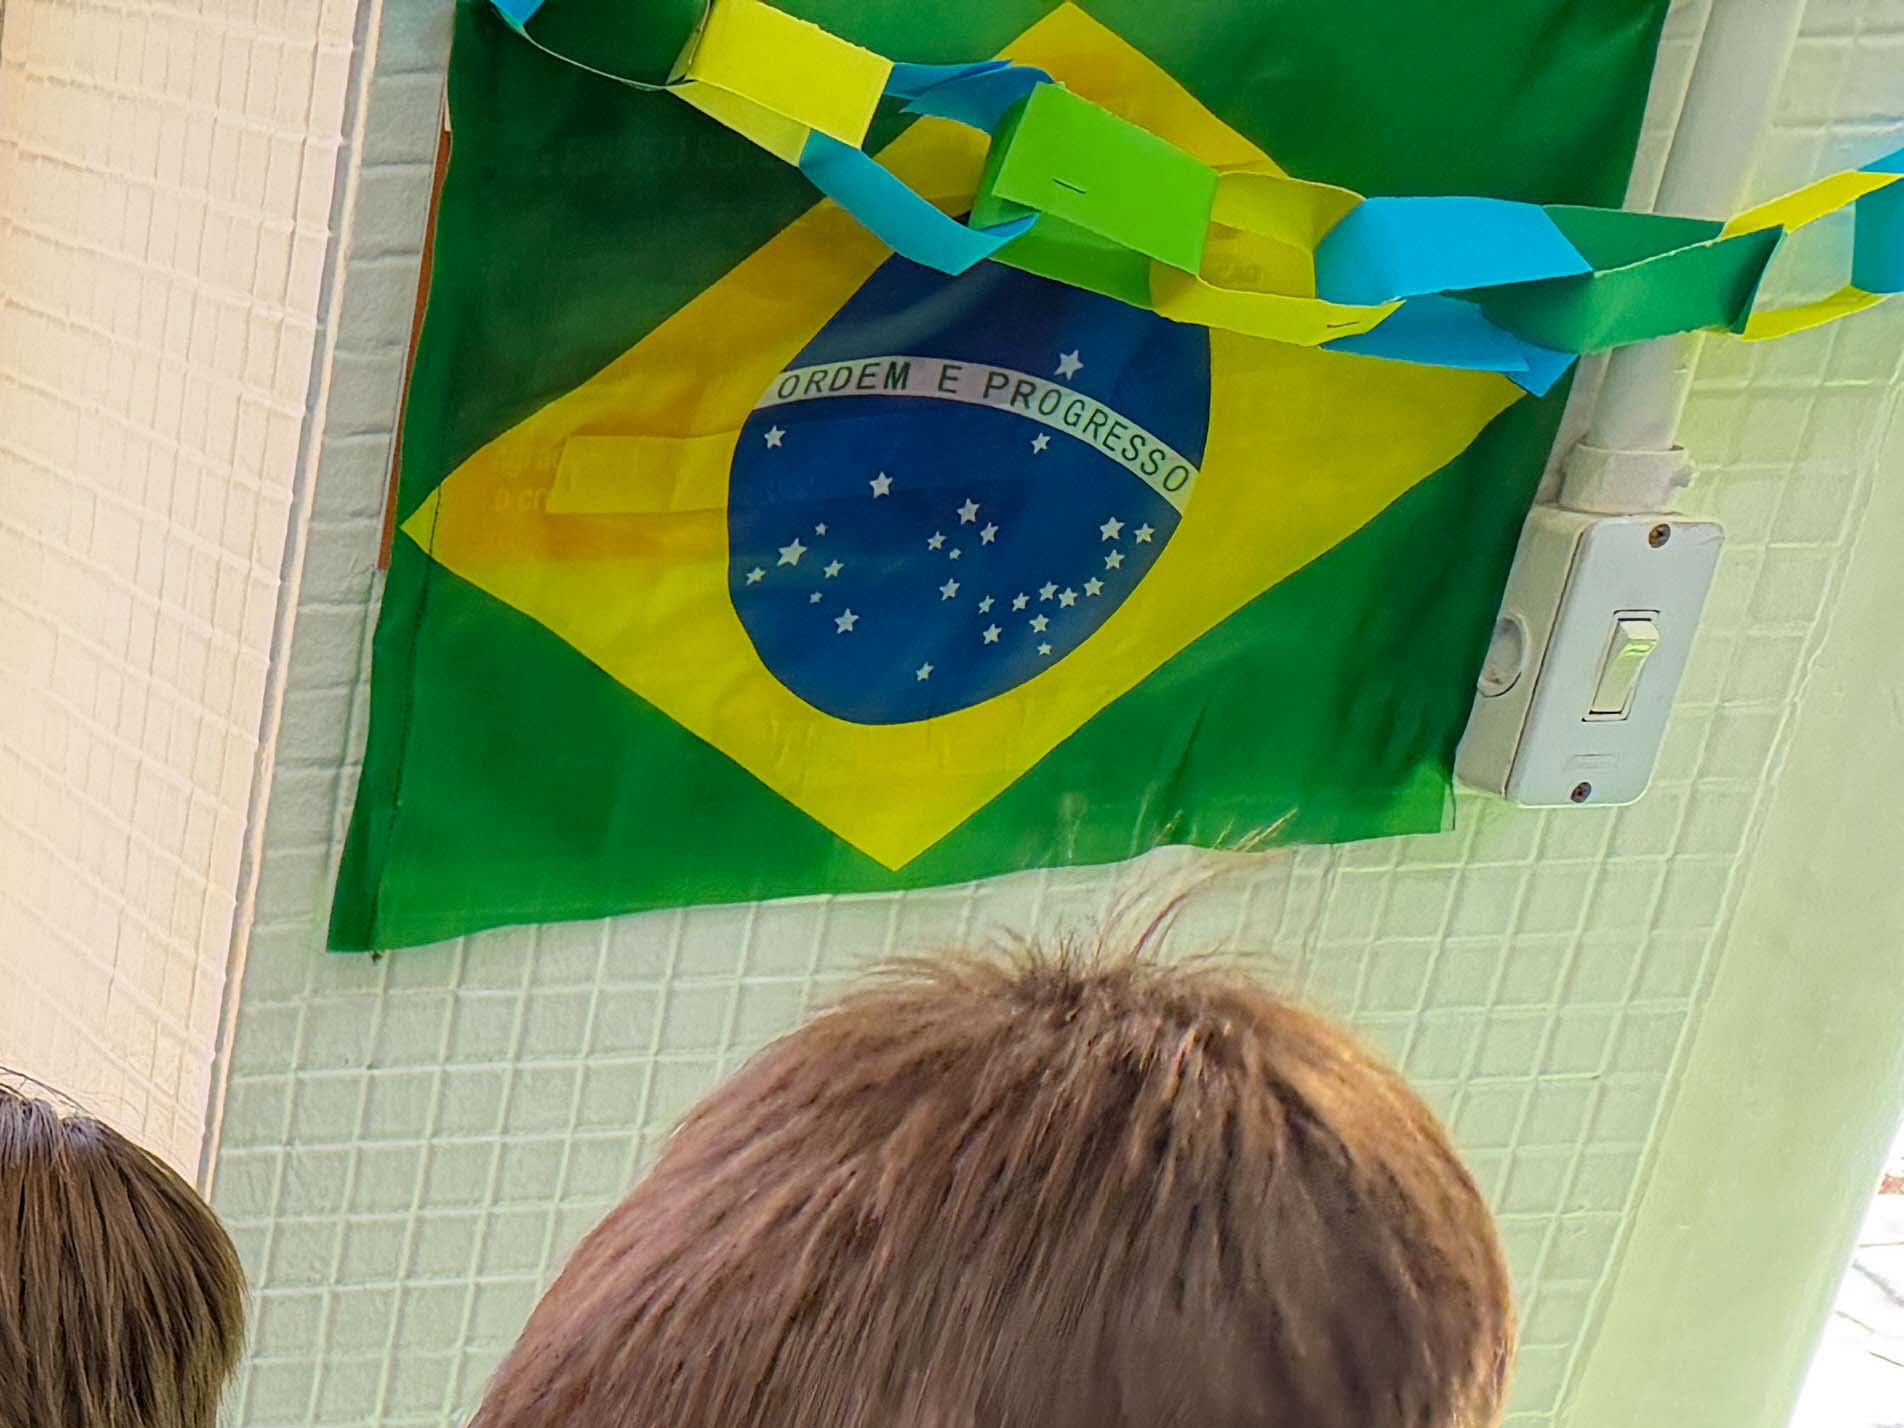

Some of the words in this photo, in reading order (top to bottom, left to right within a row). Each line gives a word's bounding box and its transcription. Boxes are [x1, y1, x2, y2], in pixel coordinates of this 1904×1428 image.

[777, 361, 911, 399] ORDEM
[938, 364, 963, 394] E
[982, 372, 1191, 493] PROGRESSO
